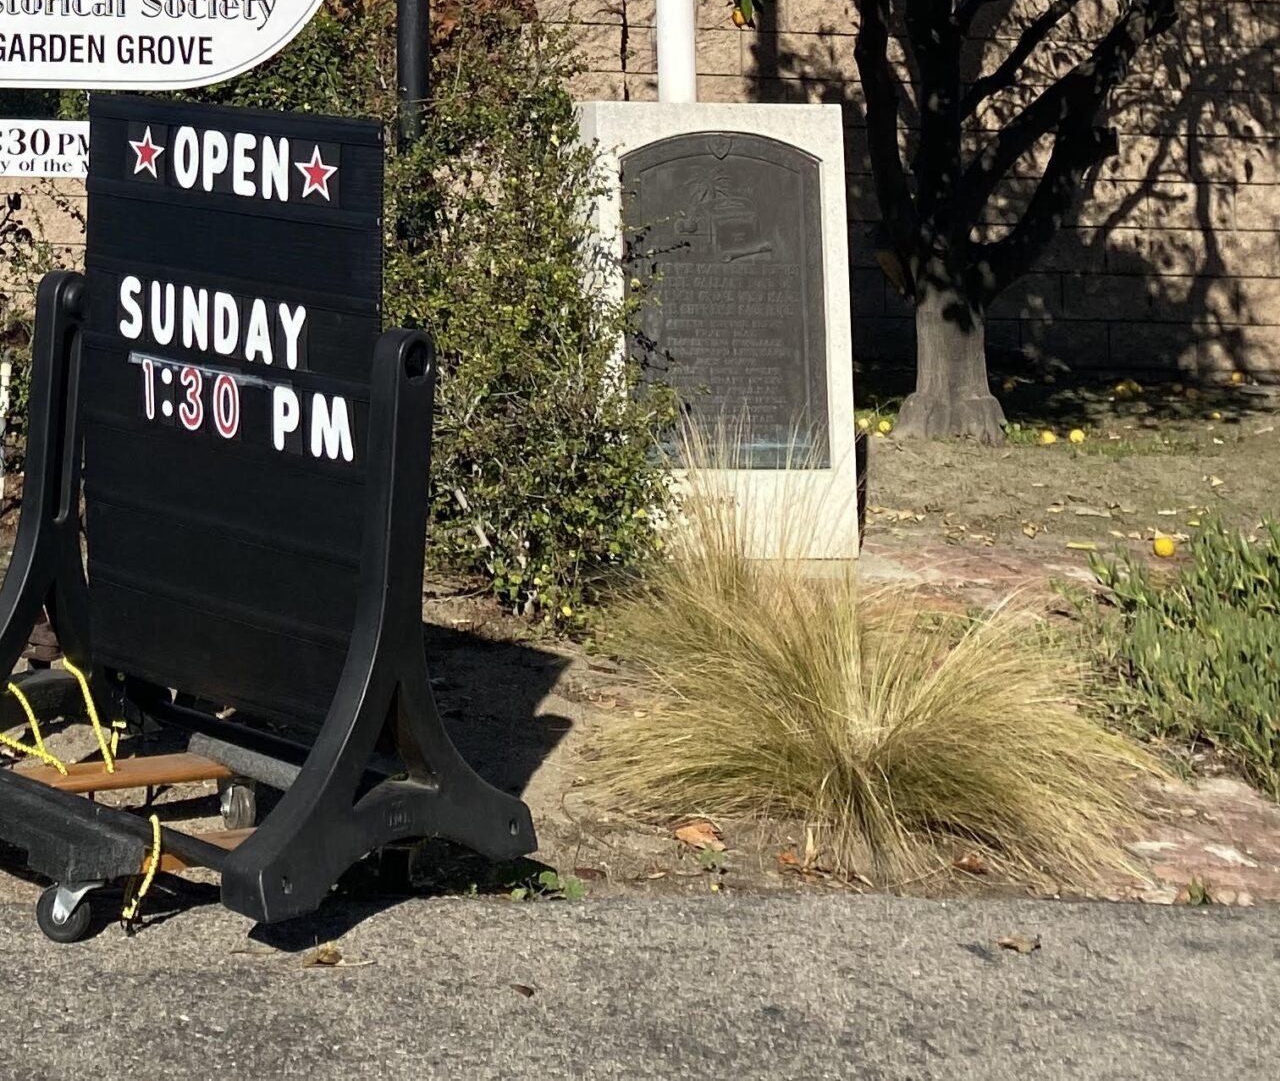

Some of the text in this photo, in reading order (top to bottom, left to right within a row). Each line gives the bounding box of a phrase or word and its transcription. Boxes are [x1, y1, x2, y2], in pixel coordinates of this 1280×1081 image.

[117, 34, 213, 65] GROVE
[18, 157, 37, 172] of
[43, 158, 73, 172] the
[174, 126, 289, 201] OPEN
[120, 276, 306, 370] SUNDAY
[143, 359, 354, 461] 1:30 PM
